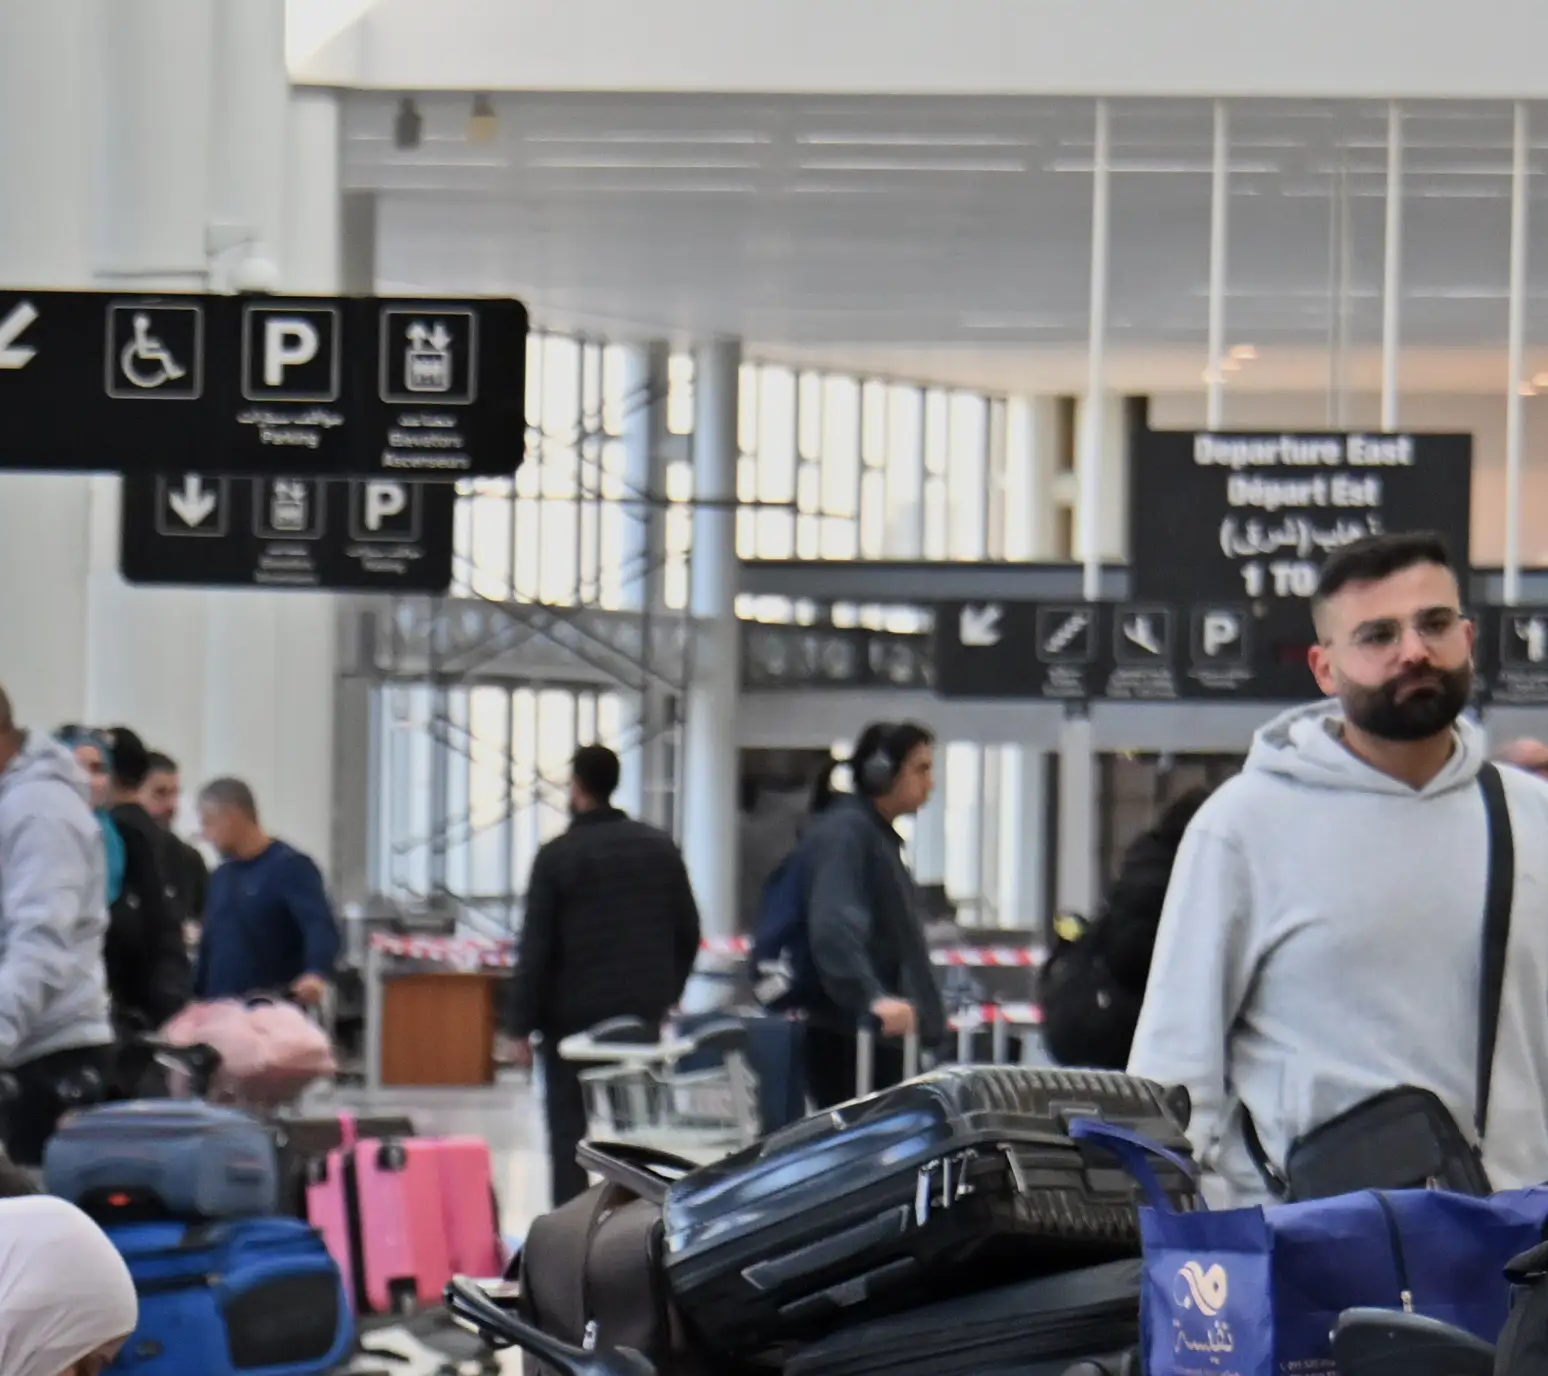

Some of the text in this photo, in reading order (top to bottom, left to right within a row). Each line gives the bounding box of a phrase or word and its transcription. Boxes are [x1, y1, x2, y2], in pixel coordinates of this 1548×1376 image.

[264, 317, 319, 386] P
[1194, 433, 1414, 470] Departure East
[365, 480, 406, 531] P
[1331, 473, 1381, 507] Est
[1241, 561, 1264, 597] 1
